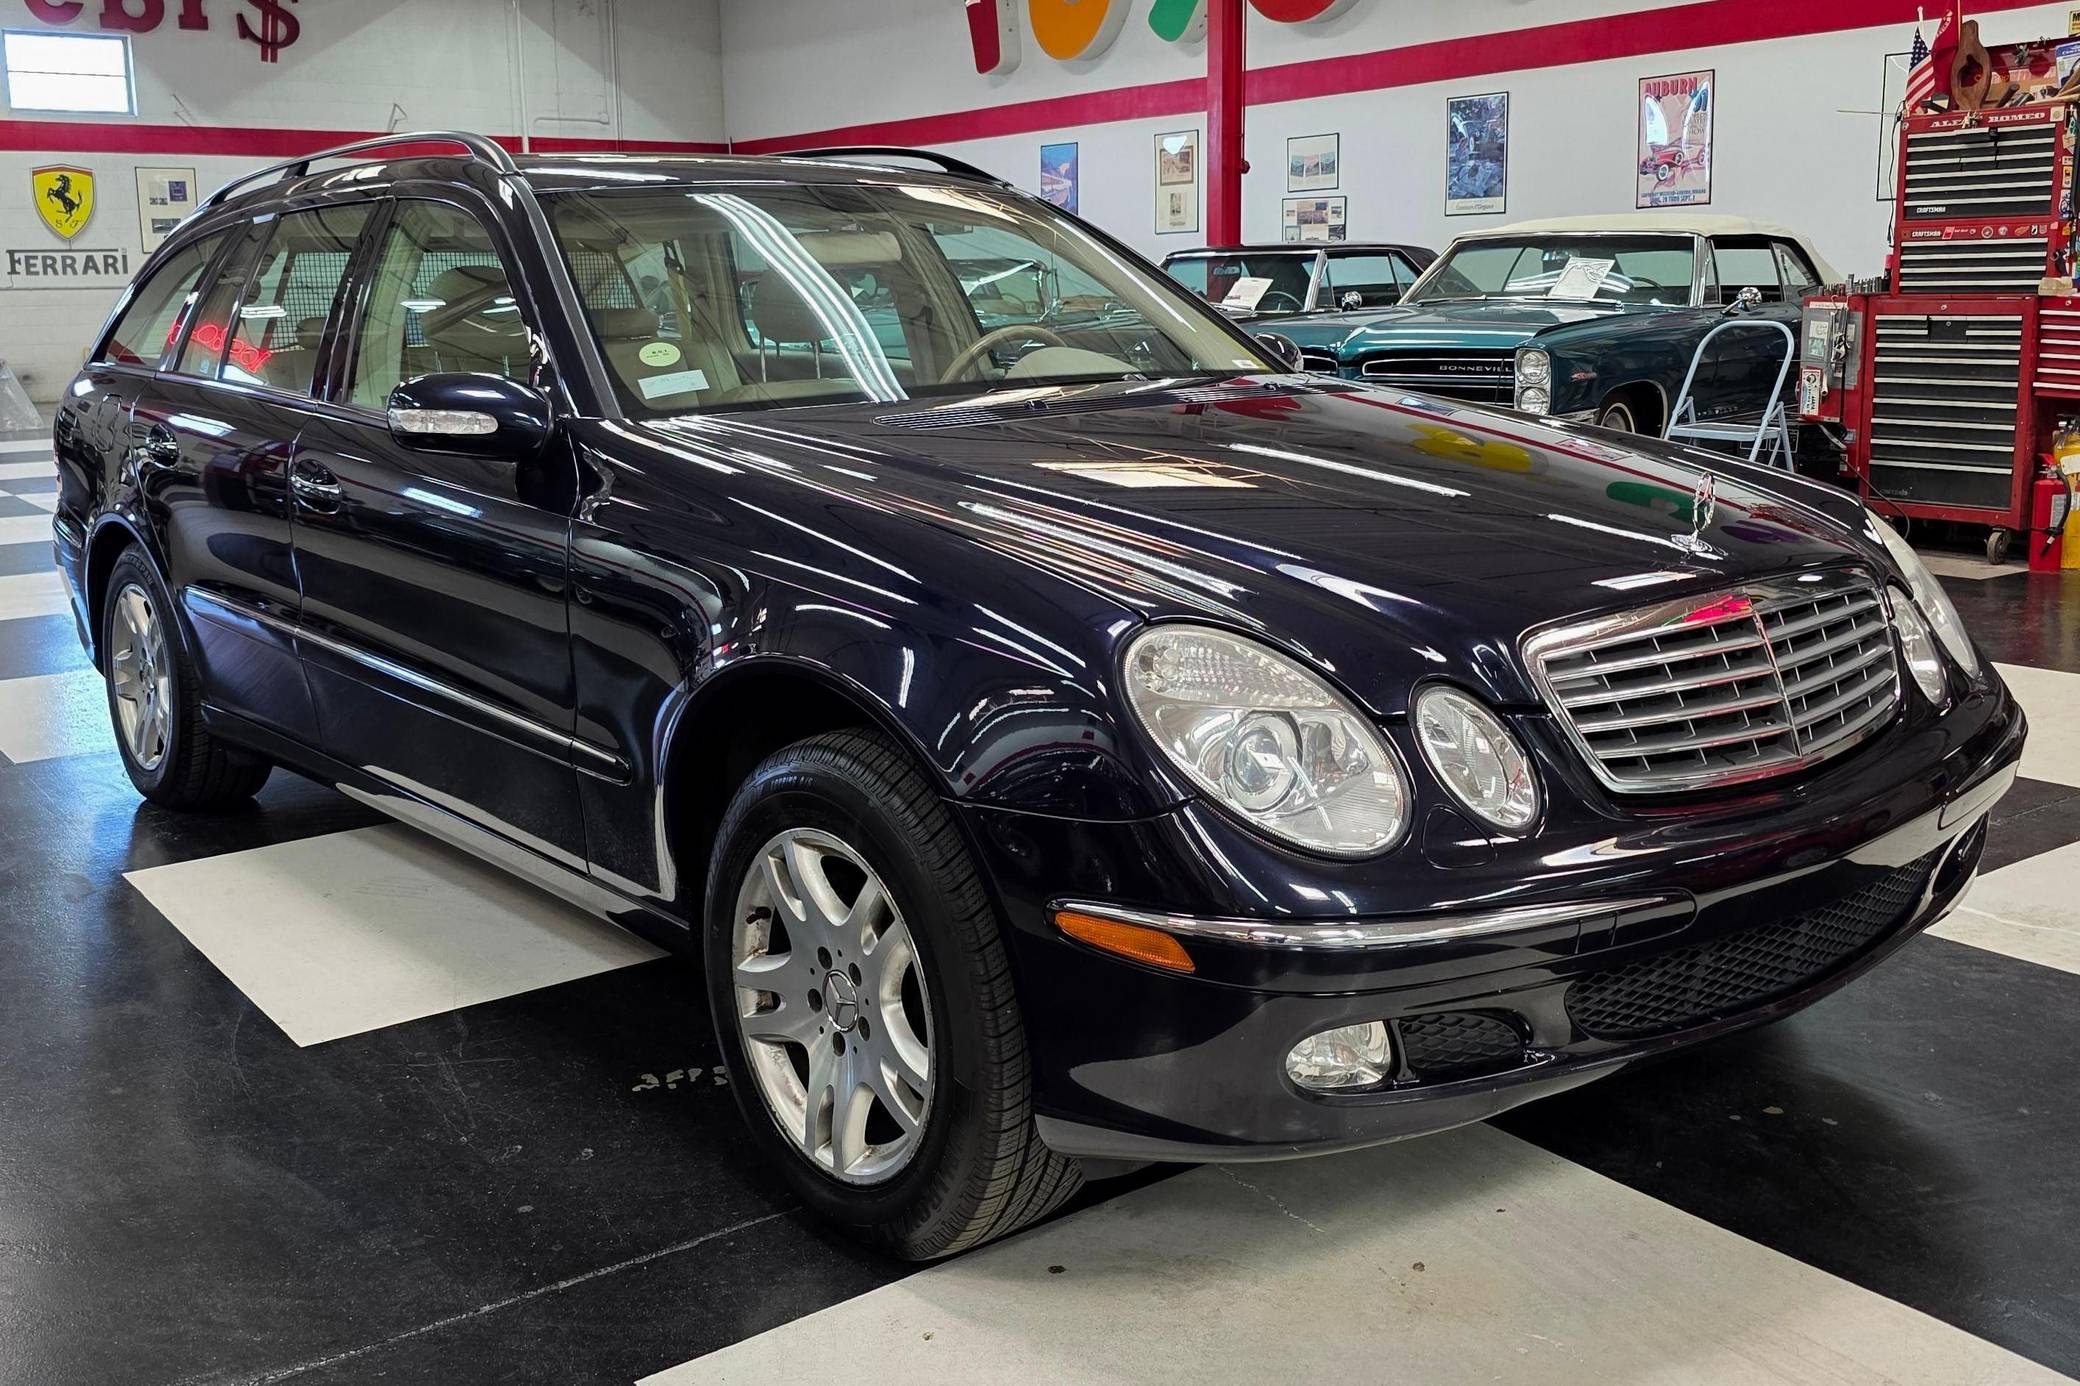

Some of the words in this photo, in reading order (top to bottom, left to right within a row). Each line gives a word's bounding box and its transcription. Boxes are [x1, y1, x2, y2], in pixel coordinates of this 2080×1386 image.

[1645, 78, 1697, 97] AUBURN
[1988, 112, 2046, 123] ROMEO
[6, 249, 128, 276] FERRARI
